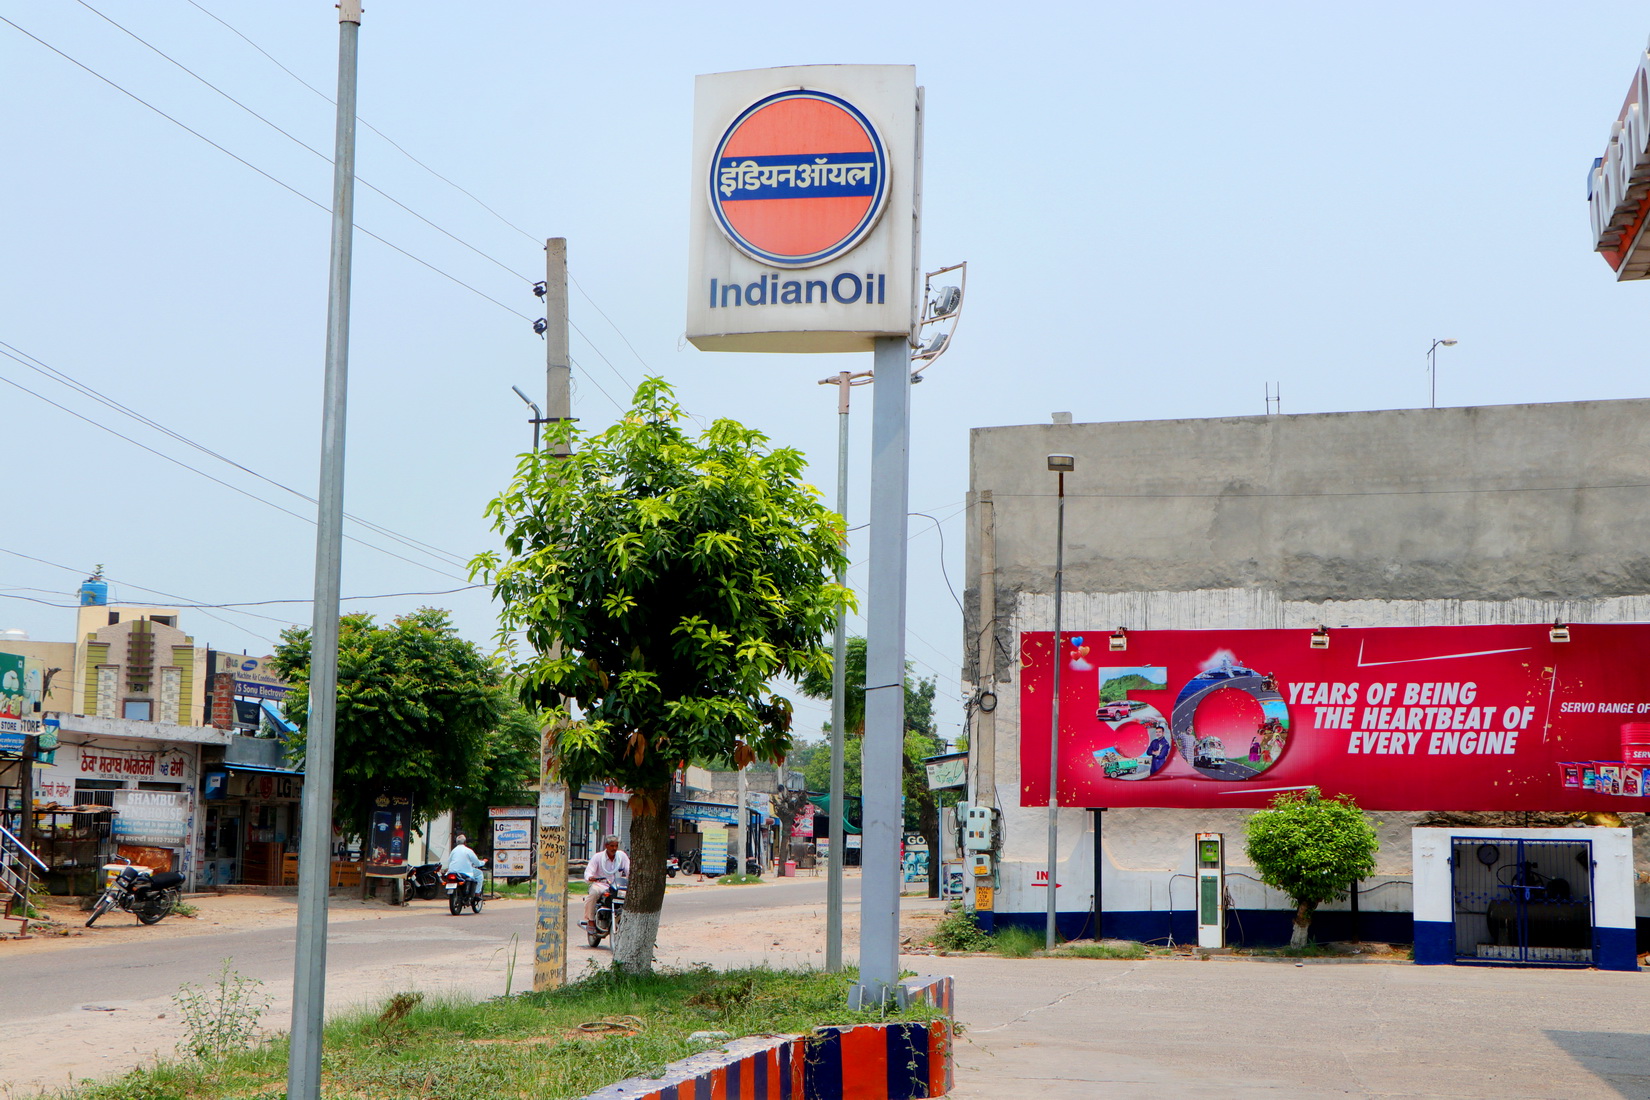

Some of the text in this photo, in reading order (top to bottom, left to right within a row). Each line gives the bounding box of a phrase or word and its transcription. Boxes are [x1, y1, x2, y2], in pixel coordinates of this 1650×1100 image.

[719, 157, 875, 198] इंडियनऑयल
[709, 272, 886, 309] IndianOil
[243, 684, 258, 695] Sonu
[1288, 681, 1477, 705] YEARS OF BEING
[1313, 706, 1535, 729] THE HEARTBEAT OF
[1560, 702, 1596, 713] SERVO
[1597, 702, 1635, 713] RANGE
[1, 720, 17, 731] STORE
[1092, 664, 1290, 781] 50
[1347, 731, 1519, 755] EVERY ENGINE
[80, 749, 98, 772] ਠੇਕਾ
[276, 777, 292, 798] LG
[127, 792, 176, 806] SHAMBU
[118, 804, 183, 821] TENT HOUSE
[495, 823, 505, 832] LG
[1036, 870, 1049, 881] IN
